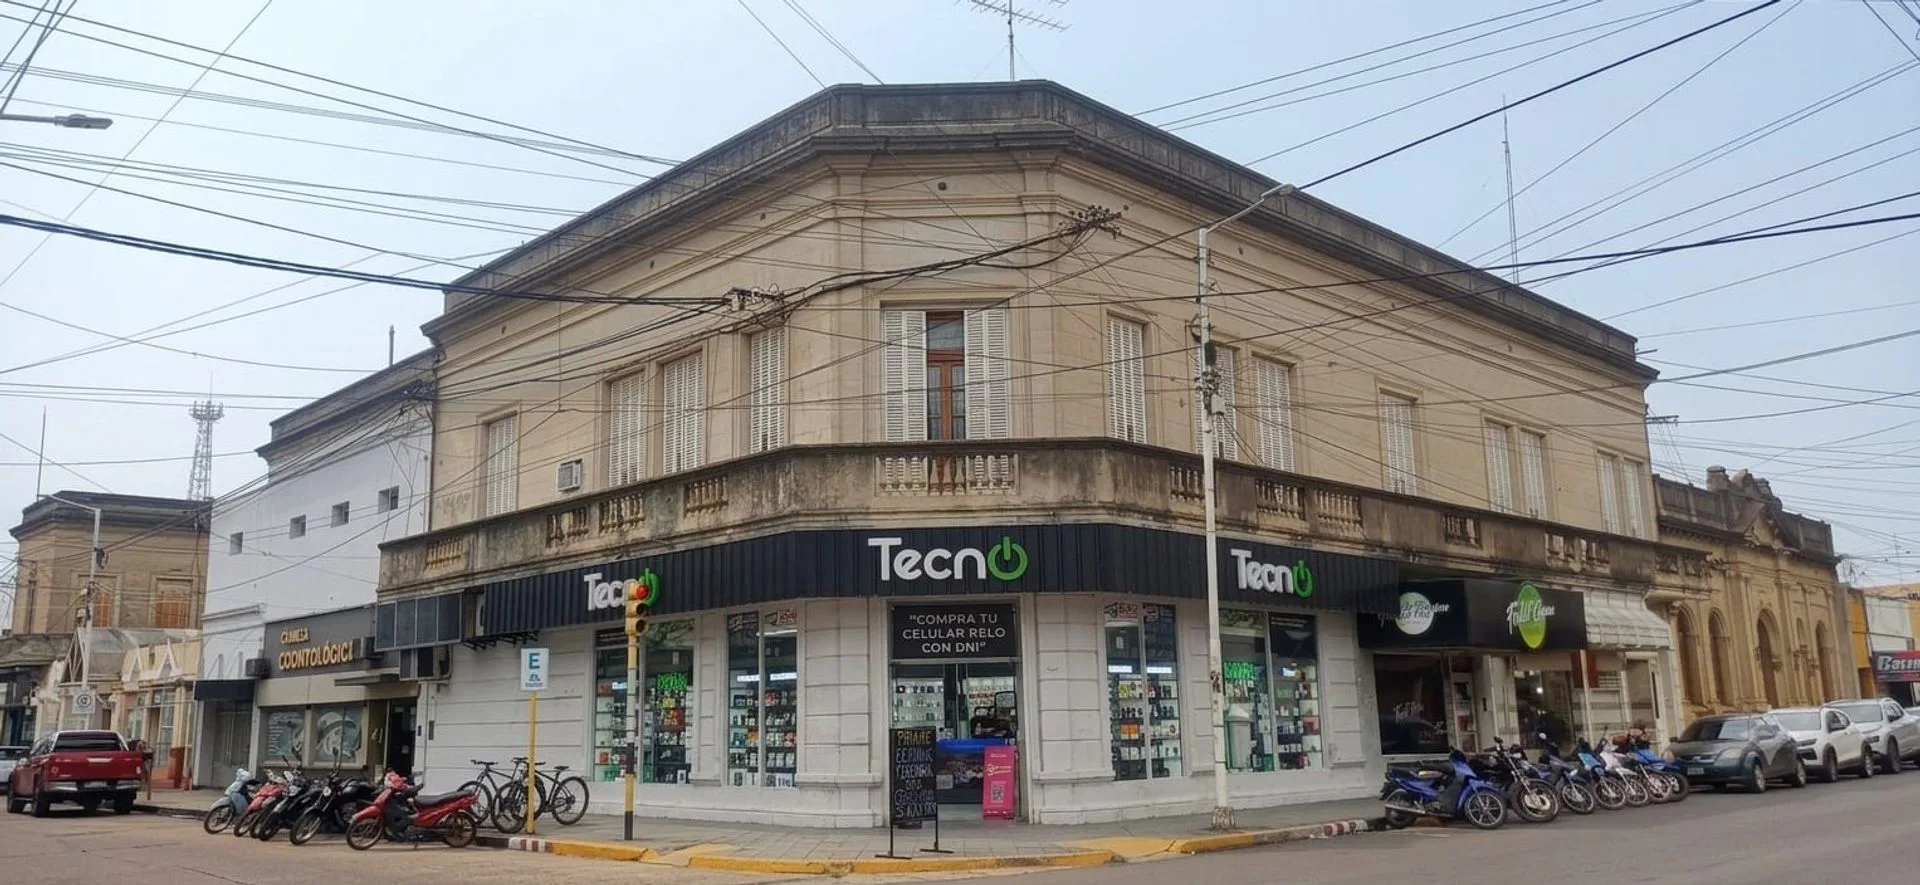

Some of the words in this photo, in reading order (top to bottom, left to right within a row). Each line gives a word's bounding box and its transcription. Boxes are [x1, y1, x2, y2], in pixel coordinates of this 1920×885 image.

[980, 613, 998, 624] TU
[902, 628, 965, 639] CELULAR
[969, 627, 1006, 638] RELO
[921, 642, 951, 653] CON
[528, 652, 541, 669] E
